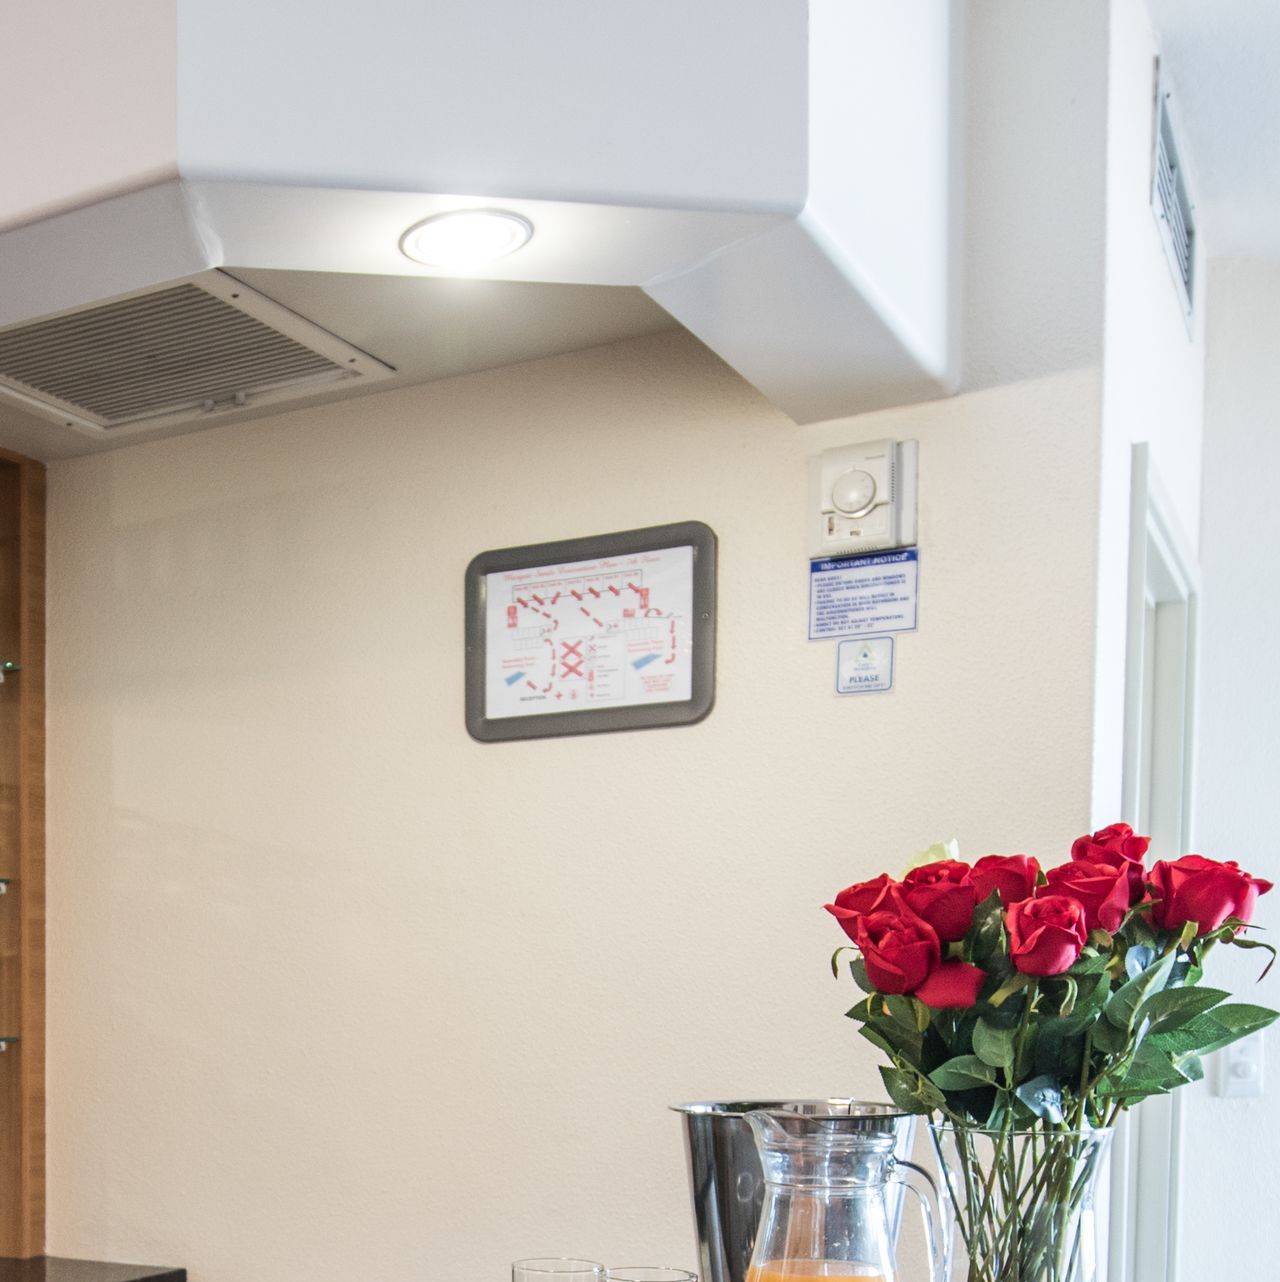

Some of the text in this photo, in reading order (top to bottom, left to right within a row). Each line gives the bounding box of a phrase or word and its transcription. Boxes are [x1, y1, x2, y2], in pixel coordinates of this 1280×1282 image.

[821, 553, 908, 570] IMPORTANT NOTICE
[849, 674, 880, 684] PLEASE
